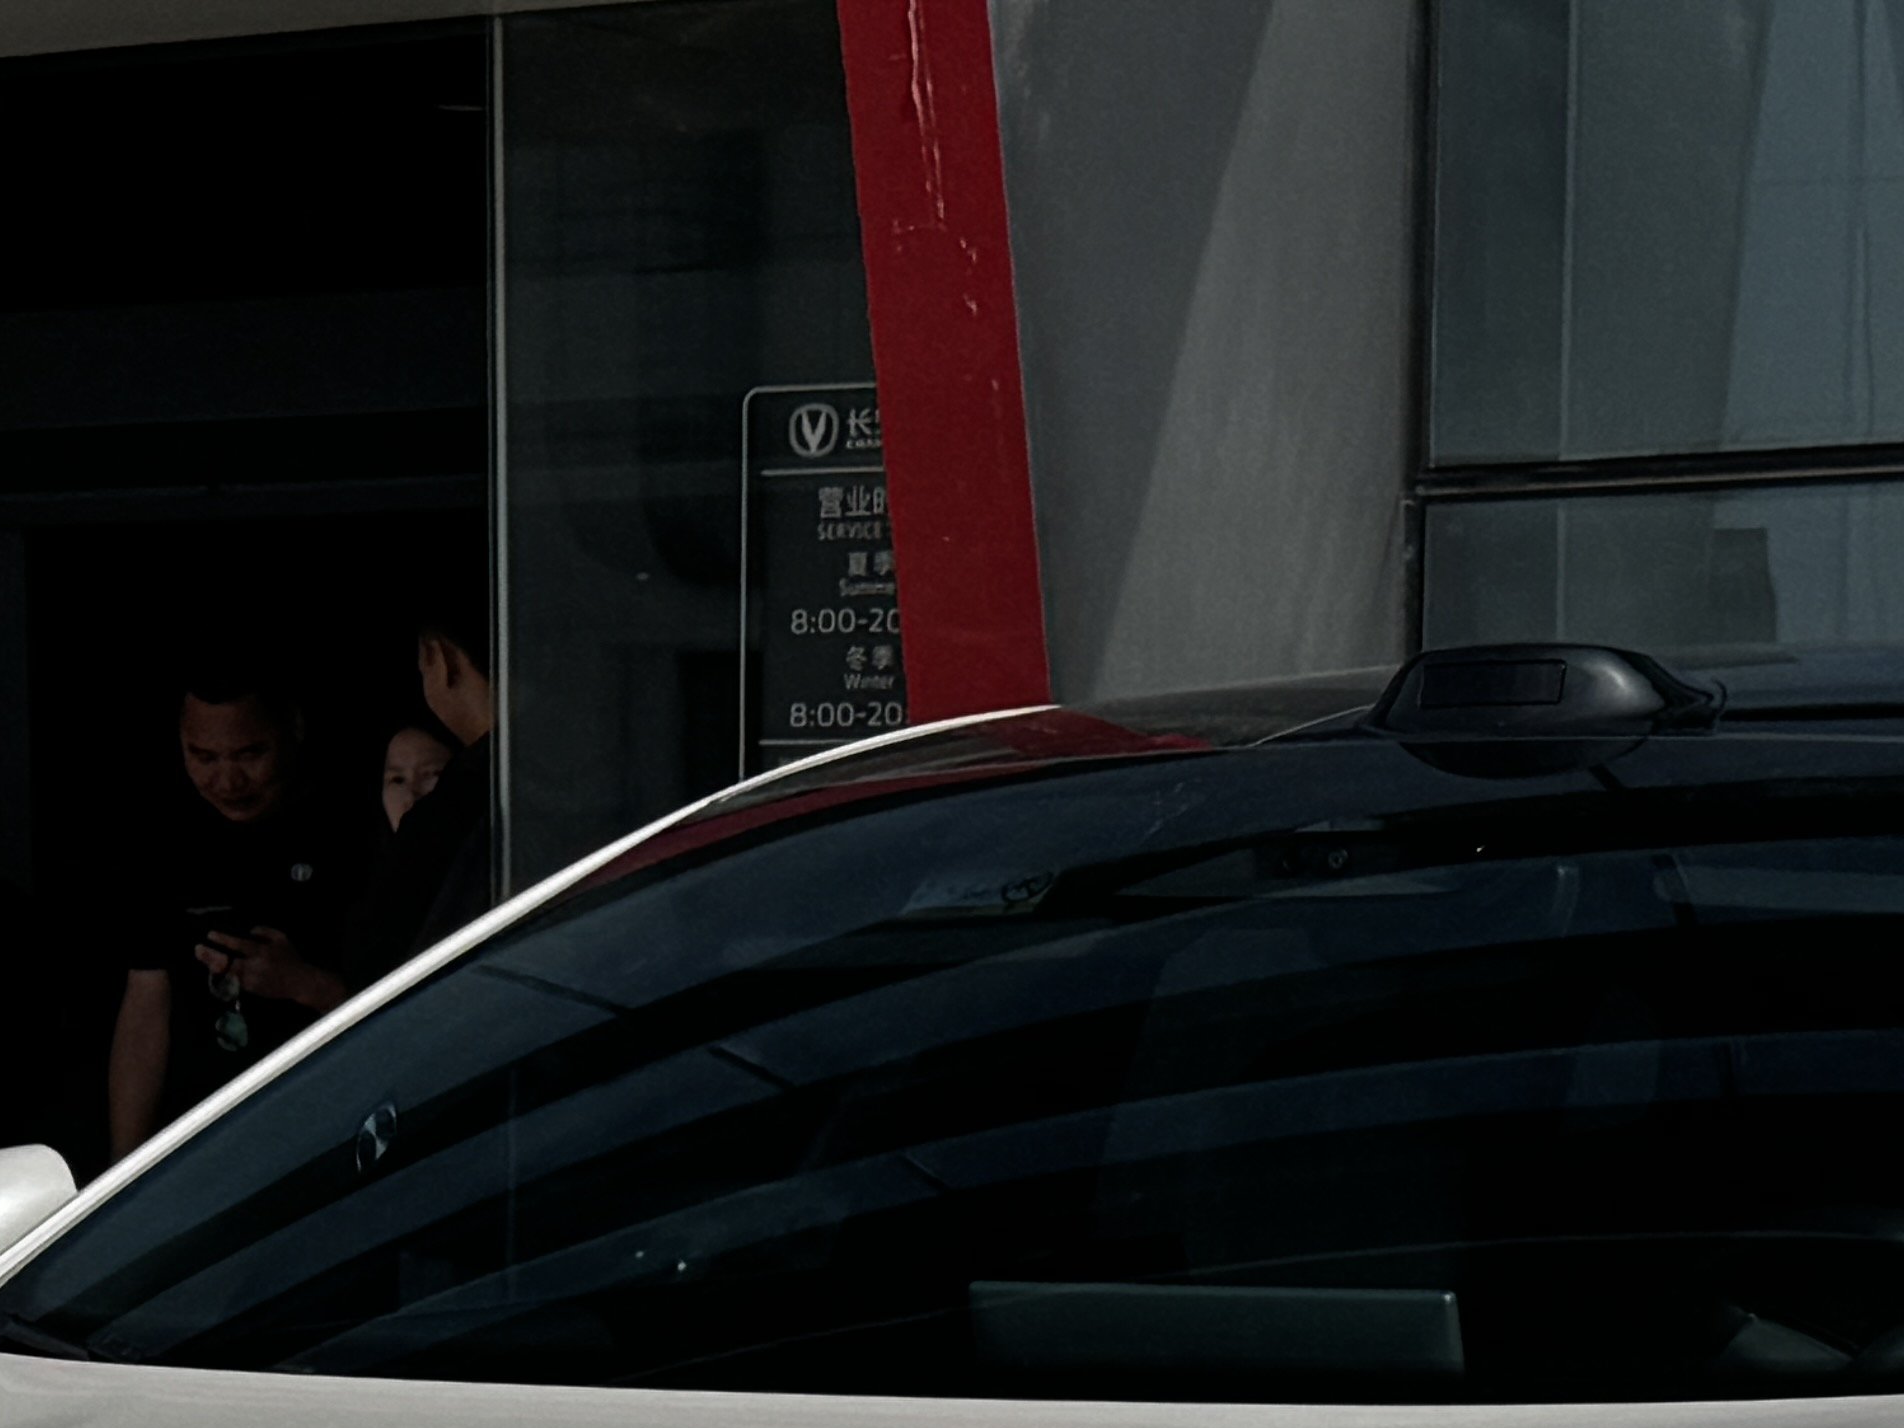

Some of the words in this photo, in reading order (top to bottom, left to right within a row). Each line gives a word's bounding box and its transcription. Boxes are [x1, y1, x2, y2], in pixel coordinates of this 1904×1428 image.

[847, 408, 881, 437] 长
[817, 520, 882, 541] SERVICE
[843, 672, 895, 690] Winter
